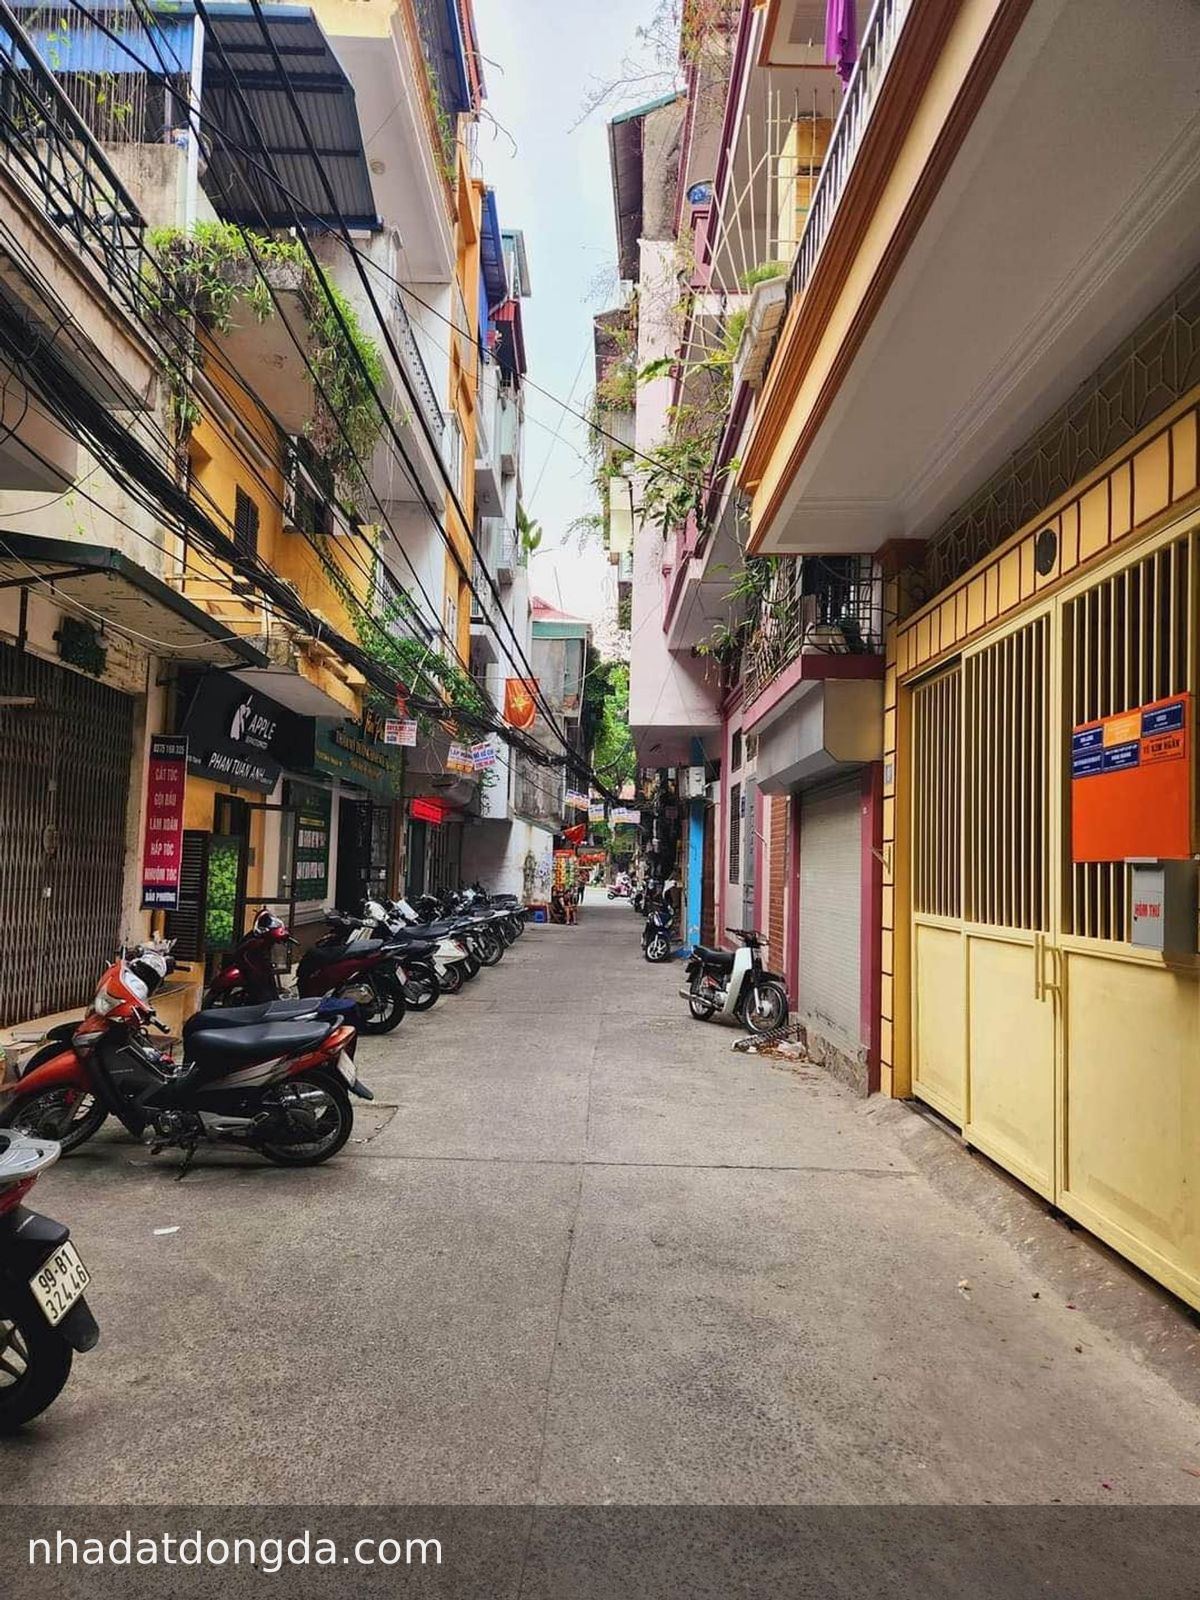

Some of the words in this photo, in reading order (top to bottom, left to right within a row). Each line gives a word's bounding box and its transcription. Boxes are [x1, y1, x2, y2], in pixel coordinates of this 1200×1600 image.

[248, 714, 276, 740] APPLE
[208, 752, 232, 773] PHAN
[249, 766, 266, 781] ANH
[163, 841, 174, 856] TÓC
[166, 866, 177, 881] TÓC
[38, 1249, 73, 1294] 99-B1
[45, 1265, 87, 1319] 324.46
